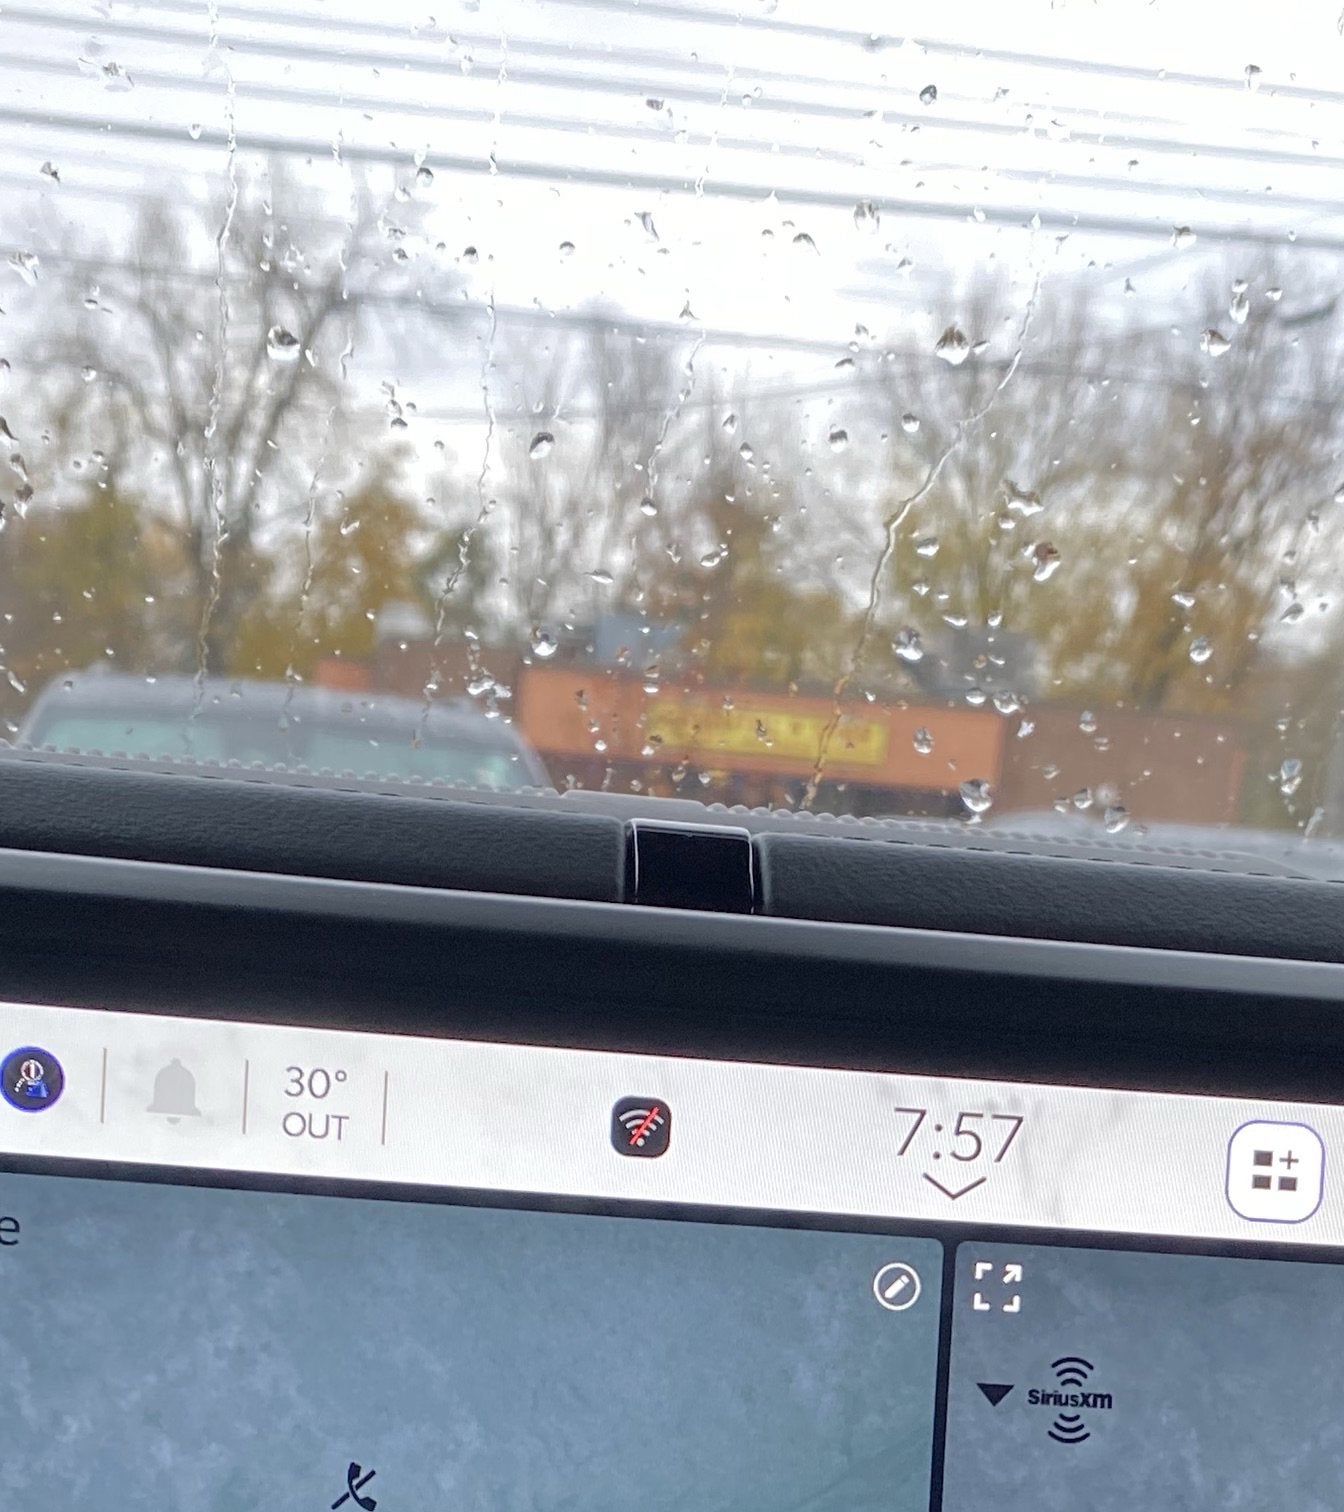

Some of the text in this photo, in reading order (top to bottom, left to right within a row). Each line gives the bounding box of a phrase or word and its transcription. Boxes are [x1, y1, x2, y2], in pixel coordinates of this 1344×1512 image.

[283, 1065, 349, 1100] 30°
[281, 1114, 350, 1142] OUT
[893, 1107, 1024, 1163] 7:57
